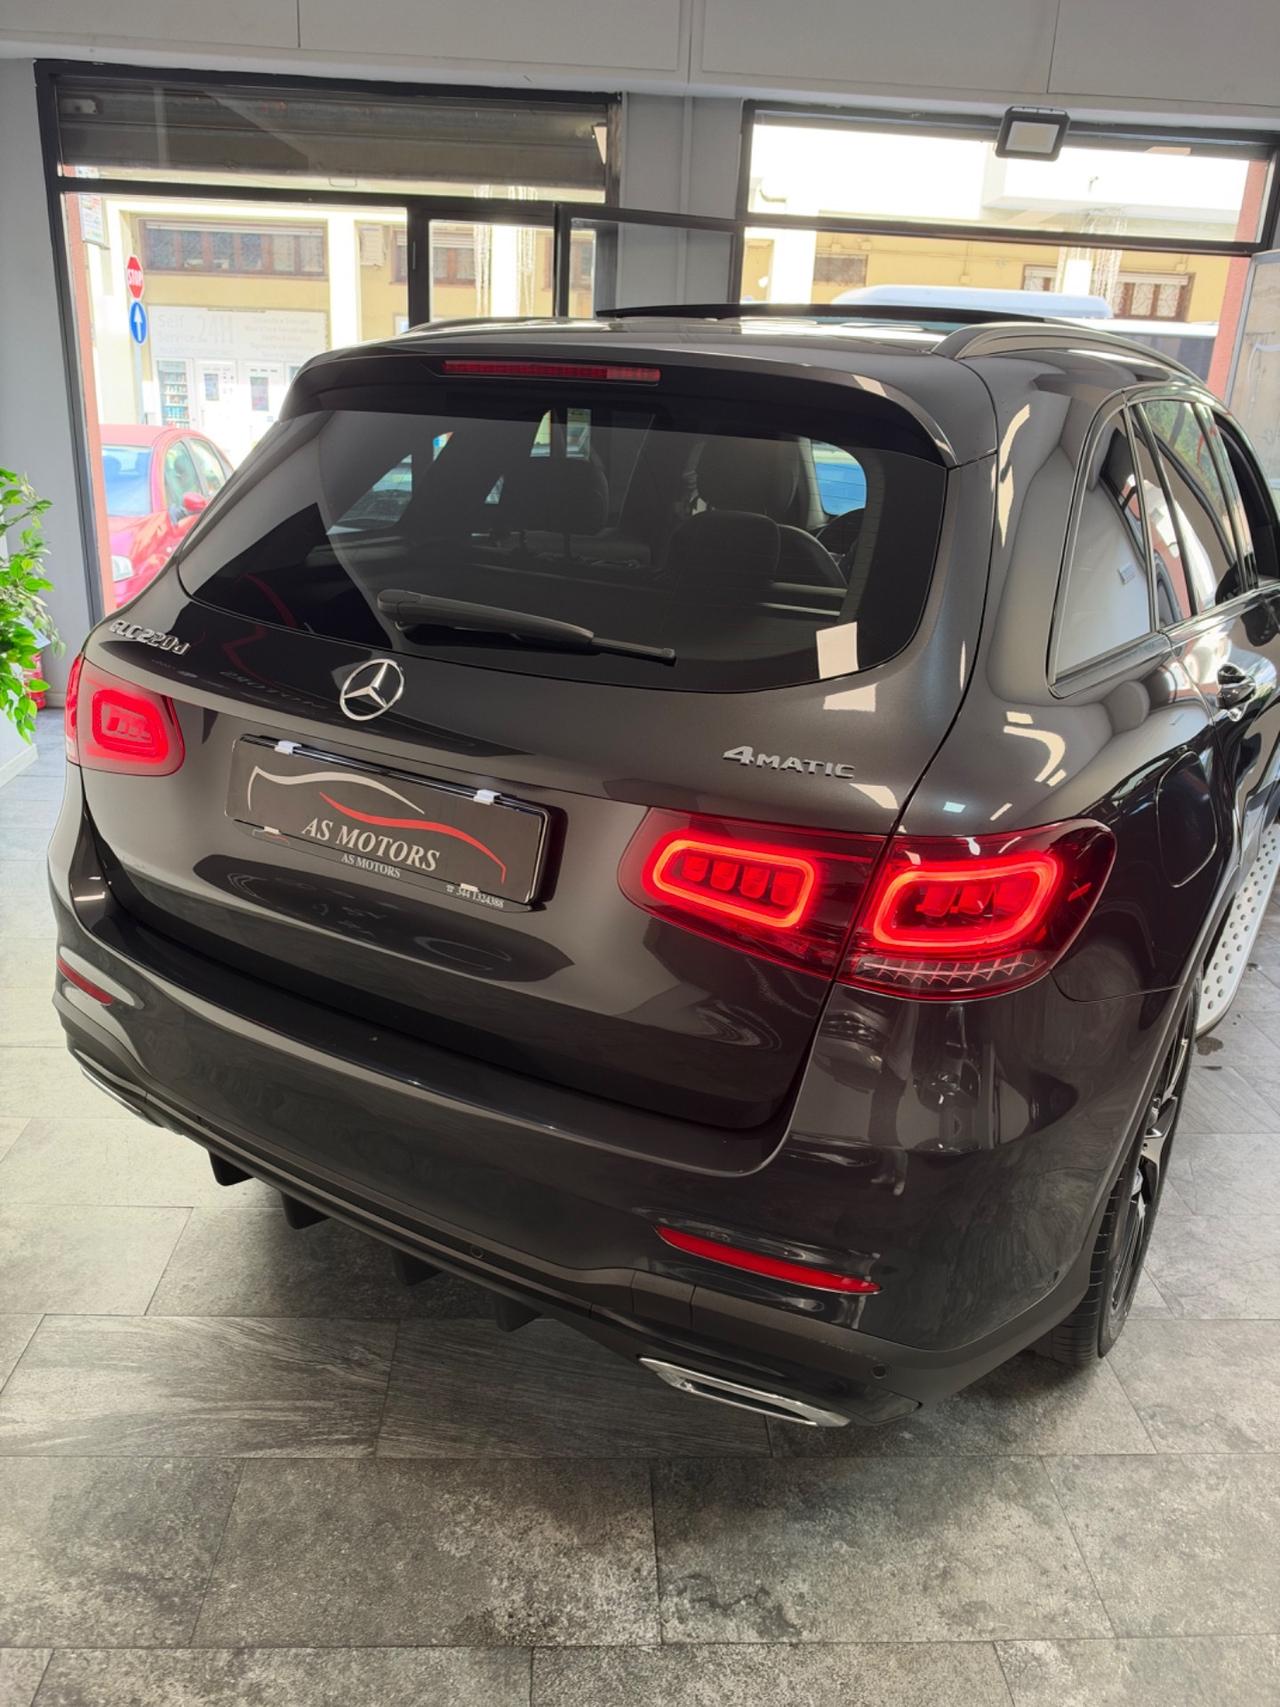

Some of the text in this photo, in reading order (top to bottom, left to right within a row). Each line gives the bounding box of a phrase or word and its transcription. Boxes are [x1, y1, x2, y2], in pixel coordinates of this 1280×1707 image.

[128, 268, 142, 286] STOP
[723, 745, 856, 779] 4MATIC
[301, 818, 440, 871] AS MOTORS
[341, 852, 401, 879] AS MOTORS
